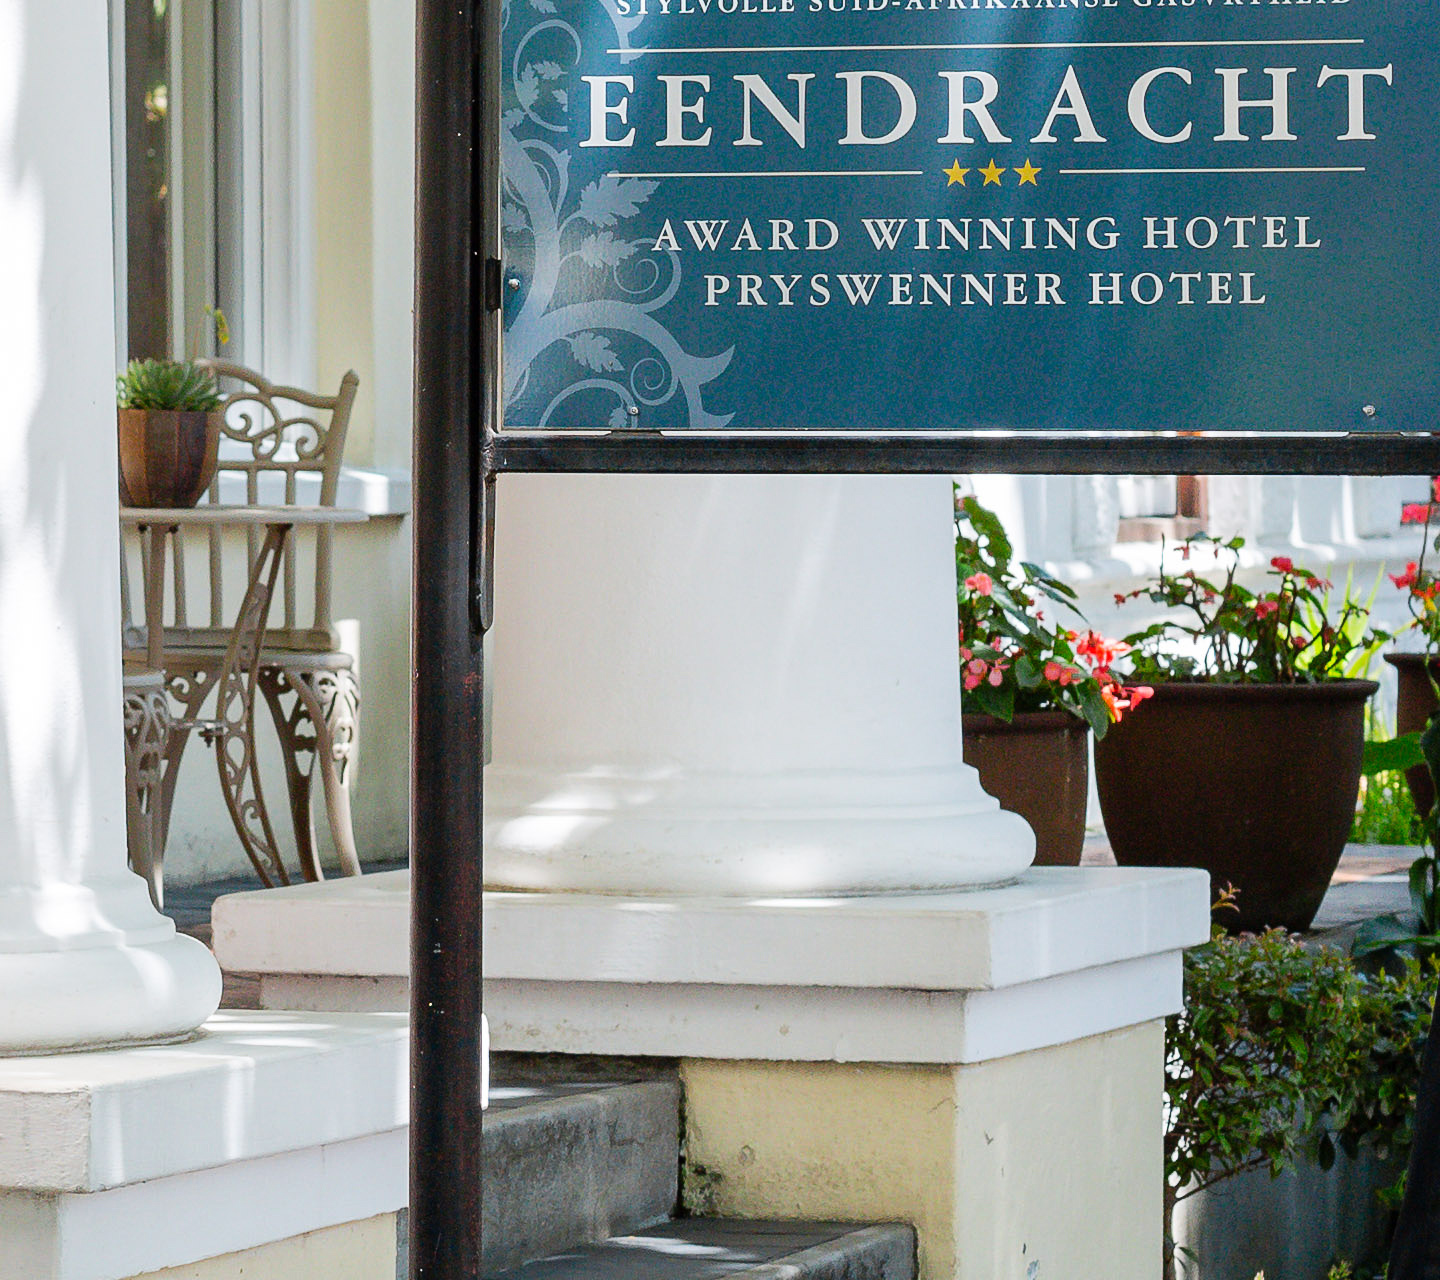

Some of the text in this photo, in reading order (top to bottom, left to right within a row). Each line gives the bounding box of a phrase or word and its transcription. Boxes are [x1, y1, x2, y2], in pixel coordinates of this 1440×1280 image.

[579, 63, 1394, 148] EENDRACHT
[652, 216, 1320, 251] AWARD WINNING HOTEL
[704, 272, 1265, 305] PRYSWENNER HOTEL
